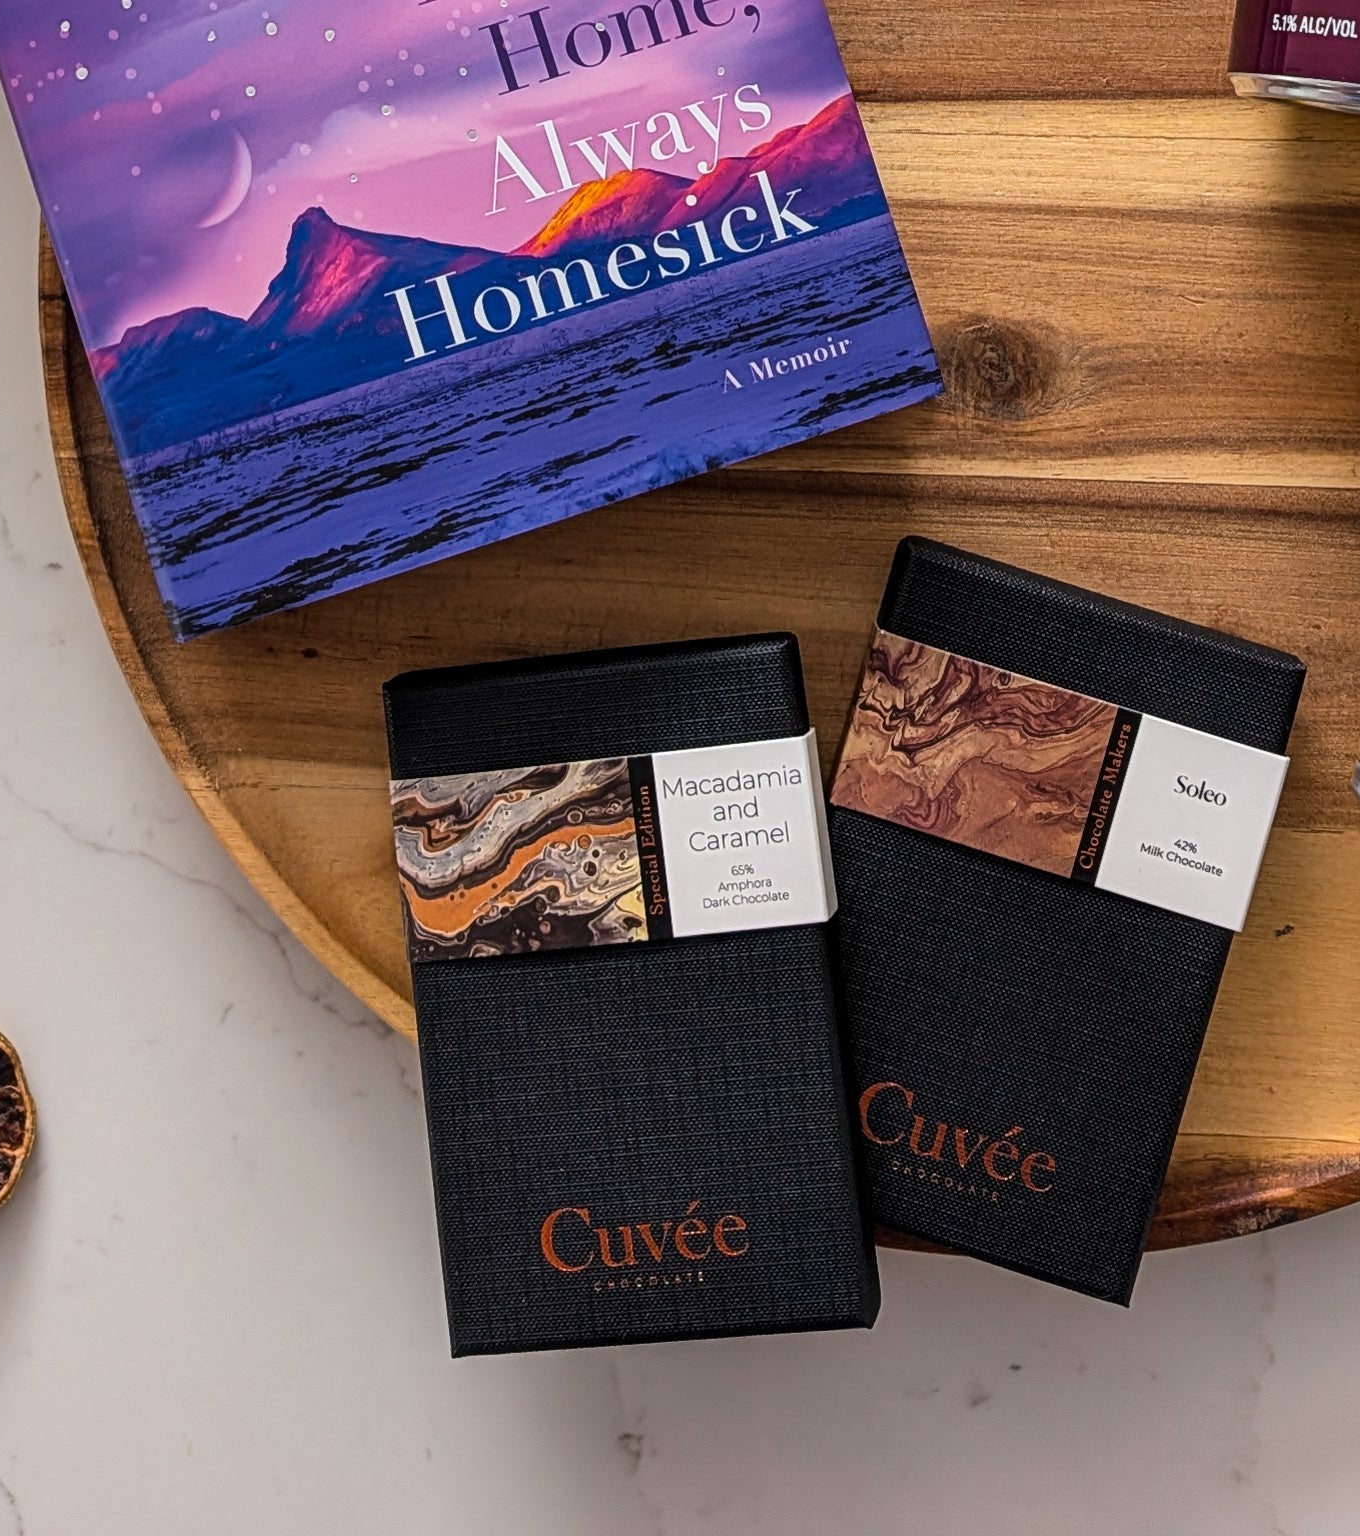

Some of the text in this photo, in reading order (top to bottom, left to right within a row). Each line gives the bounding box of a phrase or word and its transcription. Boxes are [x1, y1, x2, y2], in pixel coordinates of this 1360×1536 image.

[1272, 14, 1358, 39] 5.1% ALC/VOL
[485, 83, 772, 216] Always
[384, 170, 819, 363] Homesick
[723, 336, 851, 394] A Memoir
[661, 764, 804, 799] Macadamia
[1079, 723, 1132, 870] Chocolate Makers
[1173, 774, 1228, 807] Soleo
[712, 796, 759, 822] and
[640, 785, 667, 915] Special Edition
[688, 821, 791, 853] Caramel
[1173, 837, 1198, 855] 42%
[730, 863, 755, 876] 65%
[1139, 841, 1224, 878] Milk Chocolate
[702, 889, 791, 909] Dark Chocolate
[717, 875, 773, 895] Amphora
[858, 1081, 1057, 1193] Cuvée
[540, 1200, 750, 1274] Cuvée
